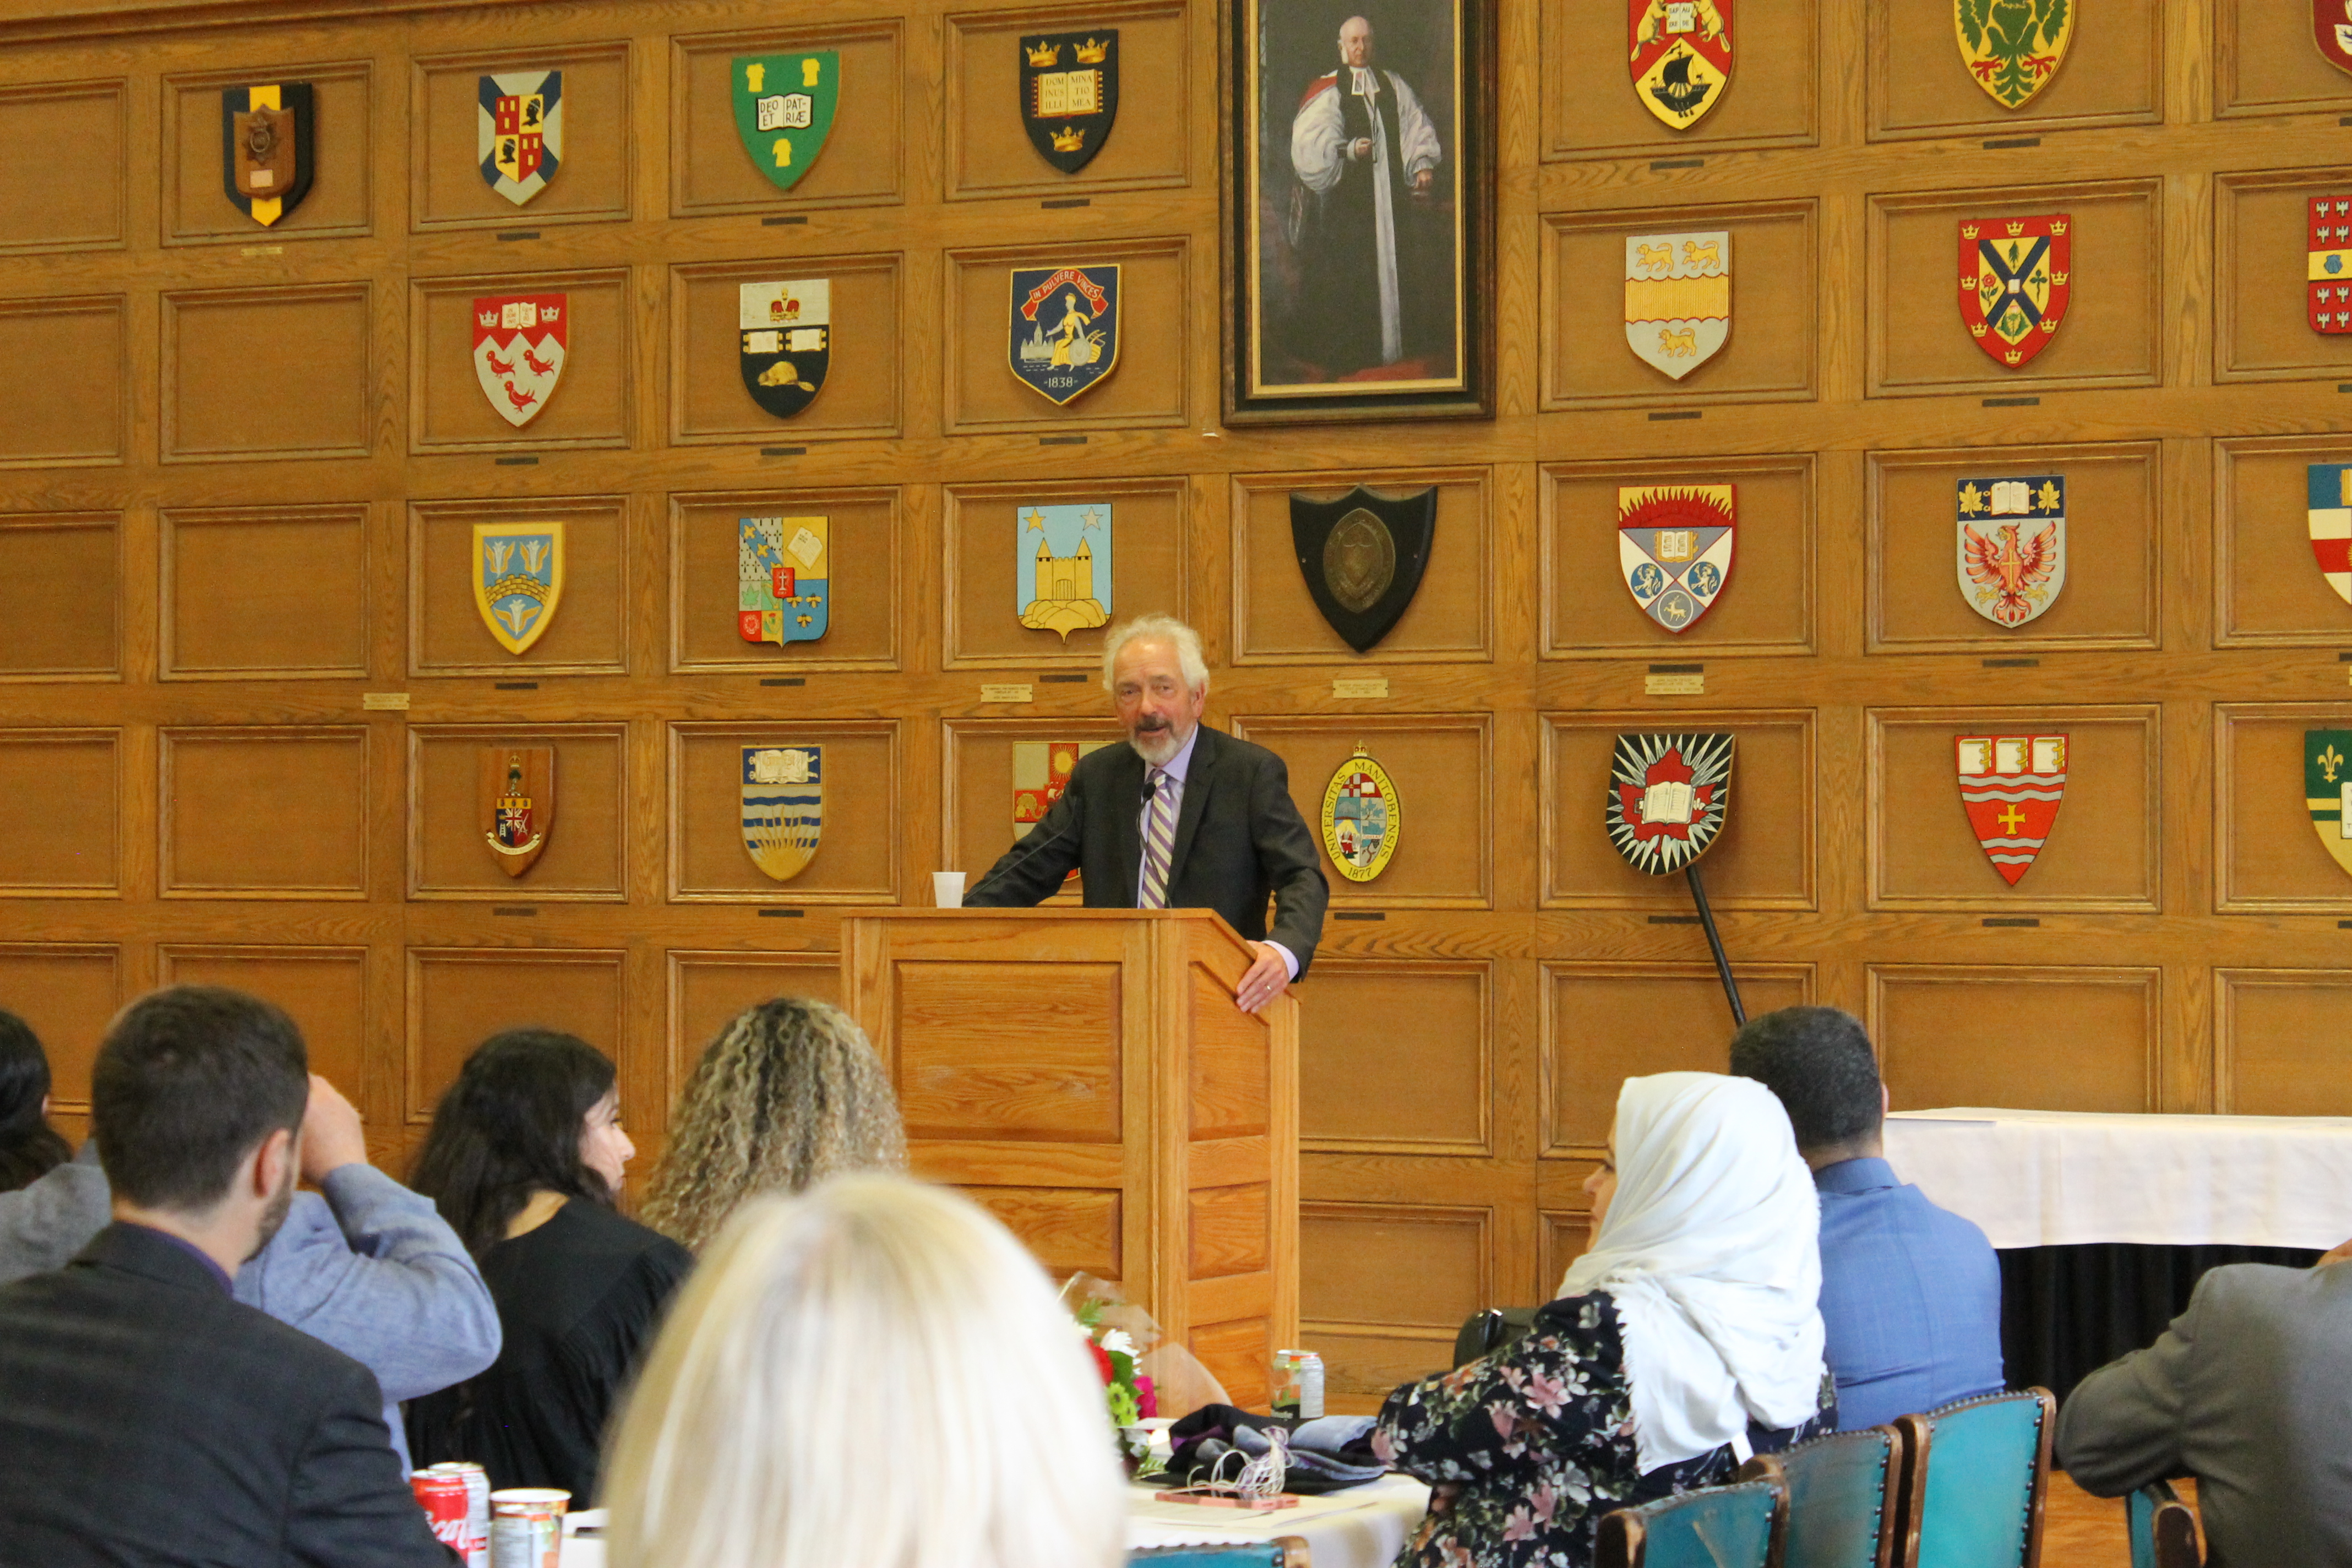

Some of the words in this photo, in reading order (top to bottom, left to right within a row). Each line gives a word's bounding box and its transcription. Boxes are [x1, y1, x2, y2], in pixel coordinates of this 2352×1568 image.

[1046, 77, 1064, 86] DOM
[760, 100, 778, 113] DEO
[786, 98, 806, 111] PAT-
[763, 113, 774, 126] ET
[1033, 290, 1042, 300] IN
[1042, 271, 1075, 293] PULVERE
[1076, 275, 1099, 298] VINCES
[1324, 772, 1346, 860] UNIVERSITAS
[1354, 762, 1397, 859] MANITOBENSIS
[1348, 868, 1371, 879] 1877
